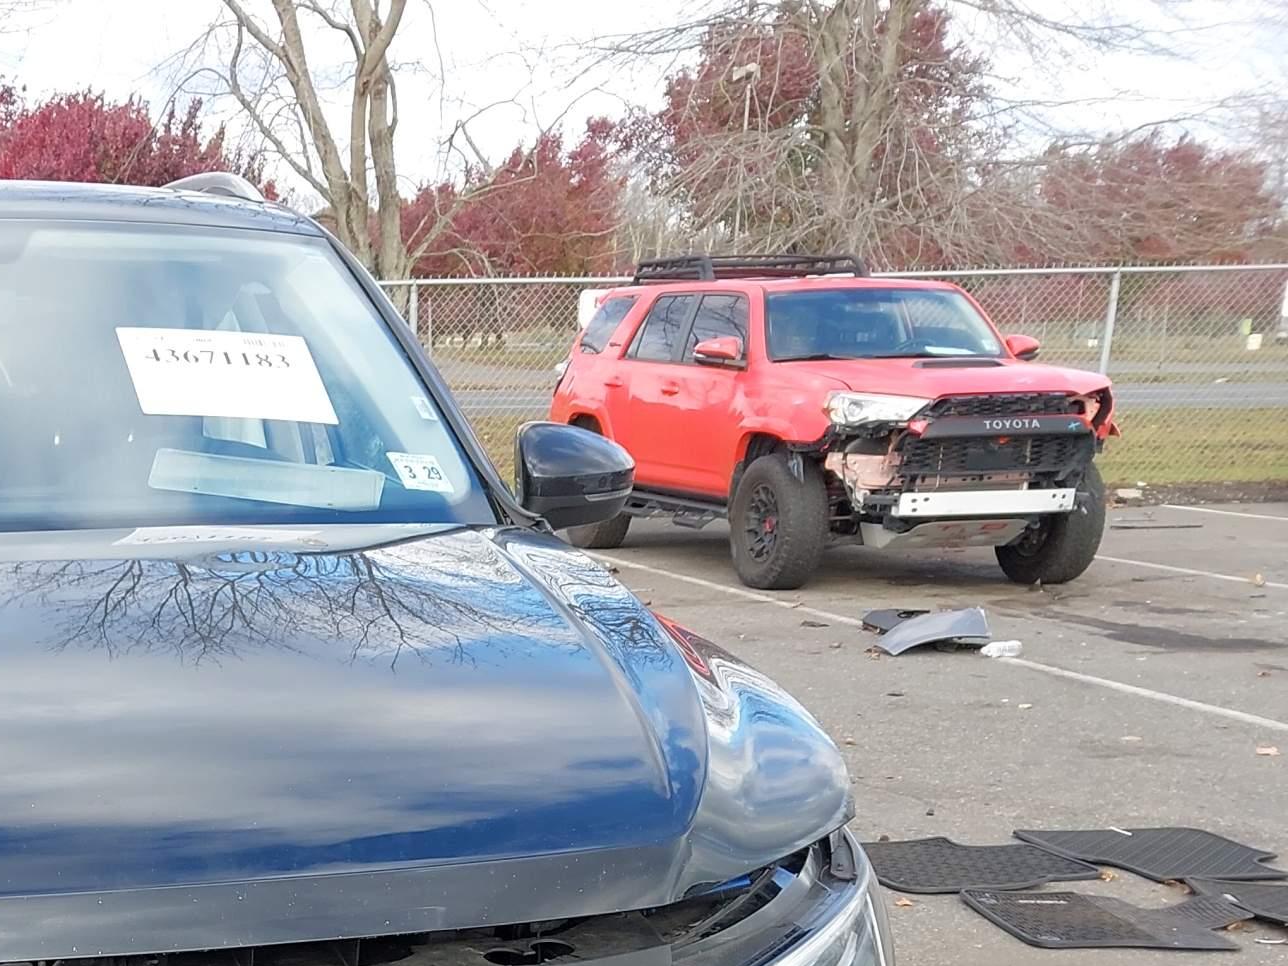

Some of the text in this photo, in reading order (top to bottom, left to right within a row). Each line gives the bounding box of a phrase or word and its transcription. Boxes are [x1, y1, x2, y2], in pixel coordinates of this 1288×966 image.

[983, 418, 1041, 430] TOYOTA
[403, 464, 443, 480] 3 29
